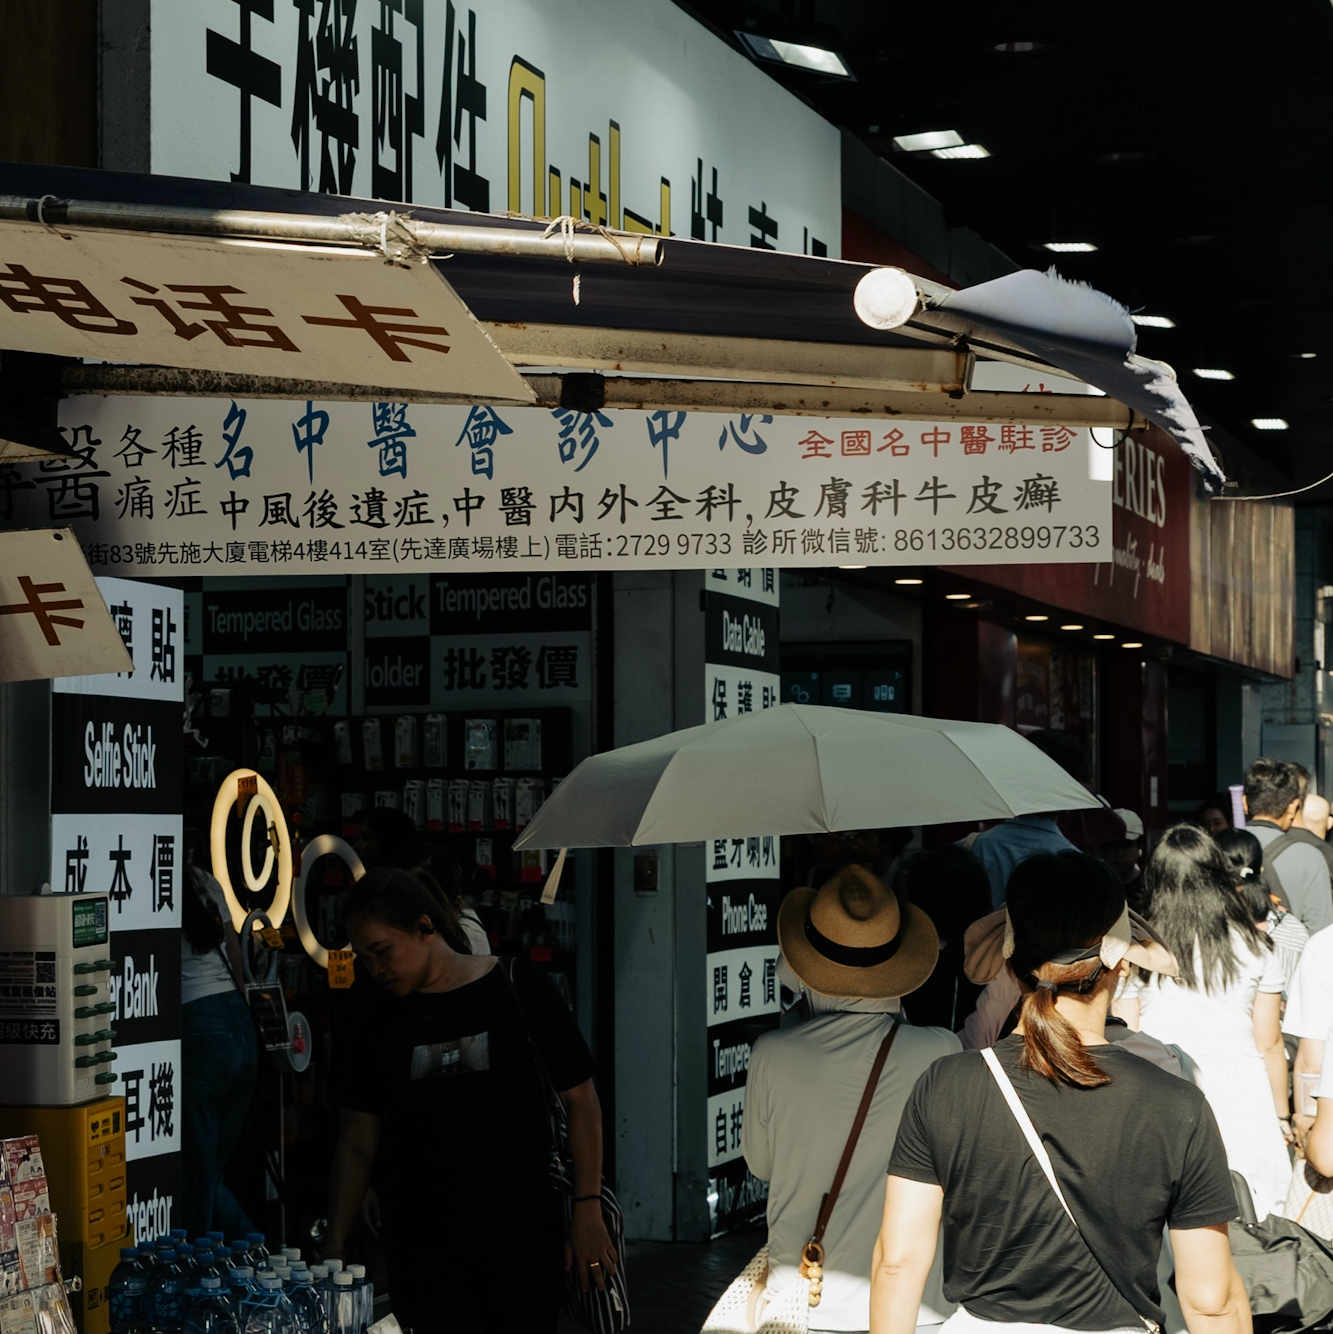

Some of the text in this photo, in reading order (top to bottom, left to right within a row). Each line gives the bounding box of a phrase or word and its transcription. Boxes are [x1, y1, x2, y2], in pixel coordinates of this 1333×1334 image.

[112, 424, 207, 469] 各種
[798, 425, 1078, 460] 全國名中醫駐診
[114, 476, 209, 522] 痛症
[80, 535, 551, 566] 街83號先施大廈電梯4樓414室(先達廣場樓上)
[676, 533, 732, 556] 9733
[894, 526, 1100, 552] 8613632899733
[365, 585, 426, 620] Stick
[435, 575, 587, 620] Tempered Glass
[207, 601, 342, 641] Tempered Glass
[723, 610, 765, 657] Data Cable
[444, 646, 578, 691] 批發價
[84, 720, 156, 789] Selfie Stick
[66, 834, 175, 913] 成本價
[722, 893, 767, 935] Phone Case
[124, 954, 159, 1019] Bank
[714, 959, 776, 1014] 開倉價
[121, 1062, 174, 1144] 耳機
